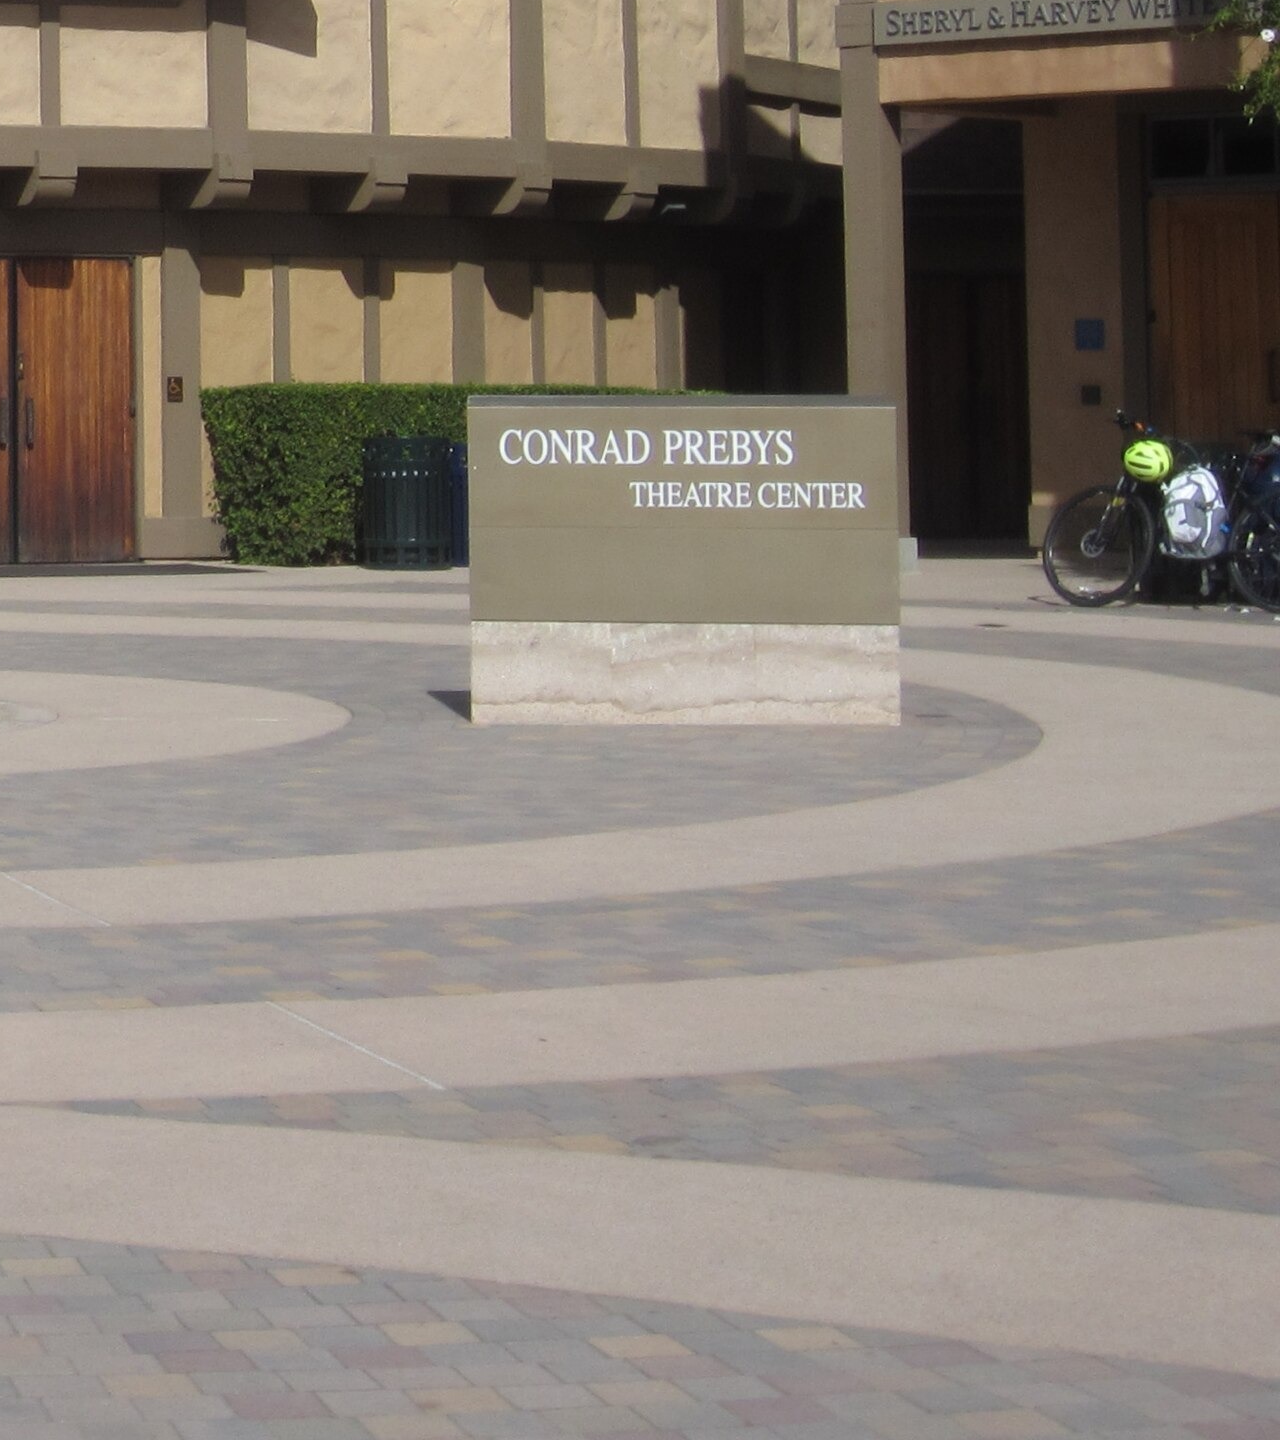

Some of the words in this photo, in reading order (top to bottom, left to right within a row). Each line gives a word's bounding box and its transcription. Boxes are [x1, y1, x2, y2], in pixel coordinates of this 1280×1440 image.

[886, 8, 981, 37] SHERYL
[987, 6, 1005, 29] &
[499, 428, 651, 465] CONRAD
[662, 428, 793, 466] PREBYS
[629, 481, 752, 508] THEATRE
[757, 481, 865, 509] CENTER
